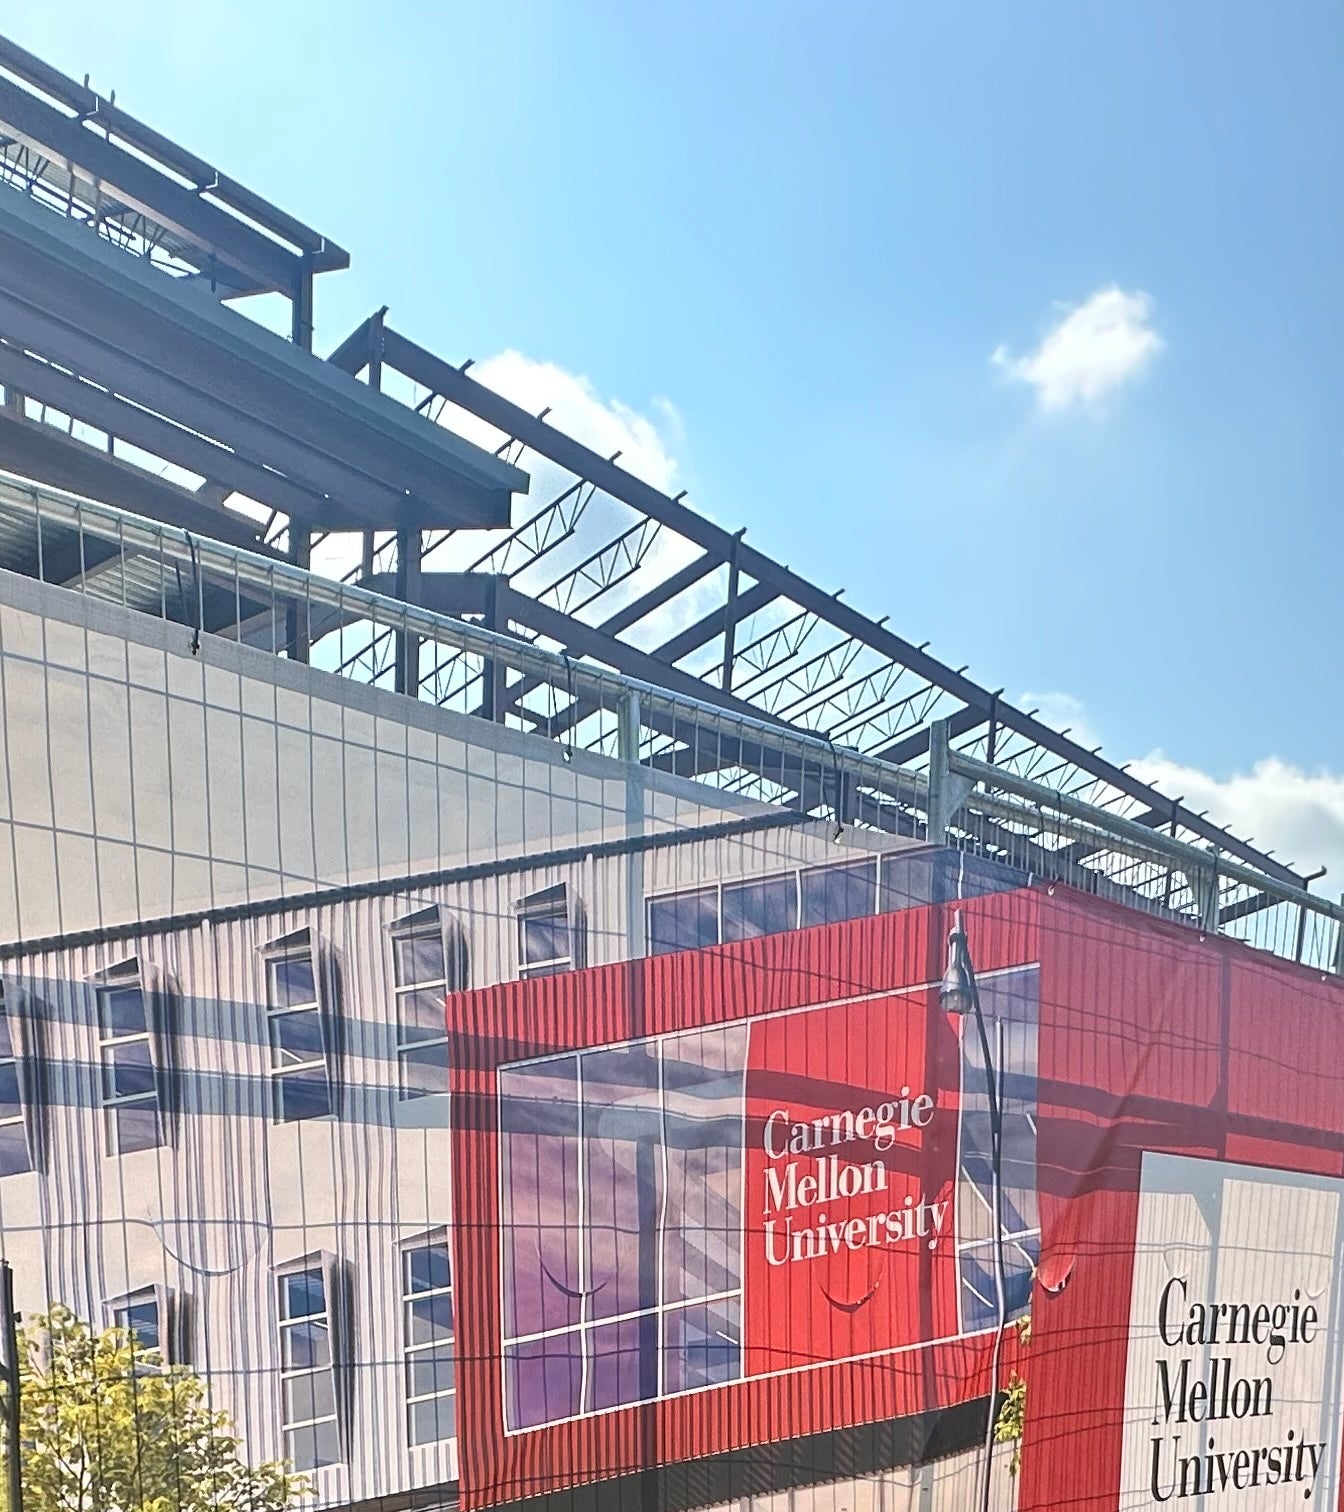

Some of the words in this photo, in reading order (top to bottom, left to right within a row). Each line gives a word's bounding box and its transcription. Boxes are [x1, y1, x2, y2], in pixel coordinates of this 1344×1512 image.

[763, 1086, 934, 1160] Carnegie
[763, 1154, 888, 1214] Mellon
[763, 1193, 948, 1266] University
[1159, 1277, 1317, 1365] Carnegie
[1152, 1358, 1273, 1425] Mellon
[1150, 1428, 1326, 1501] University
